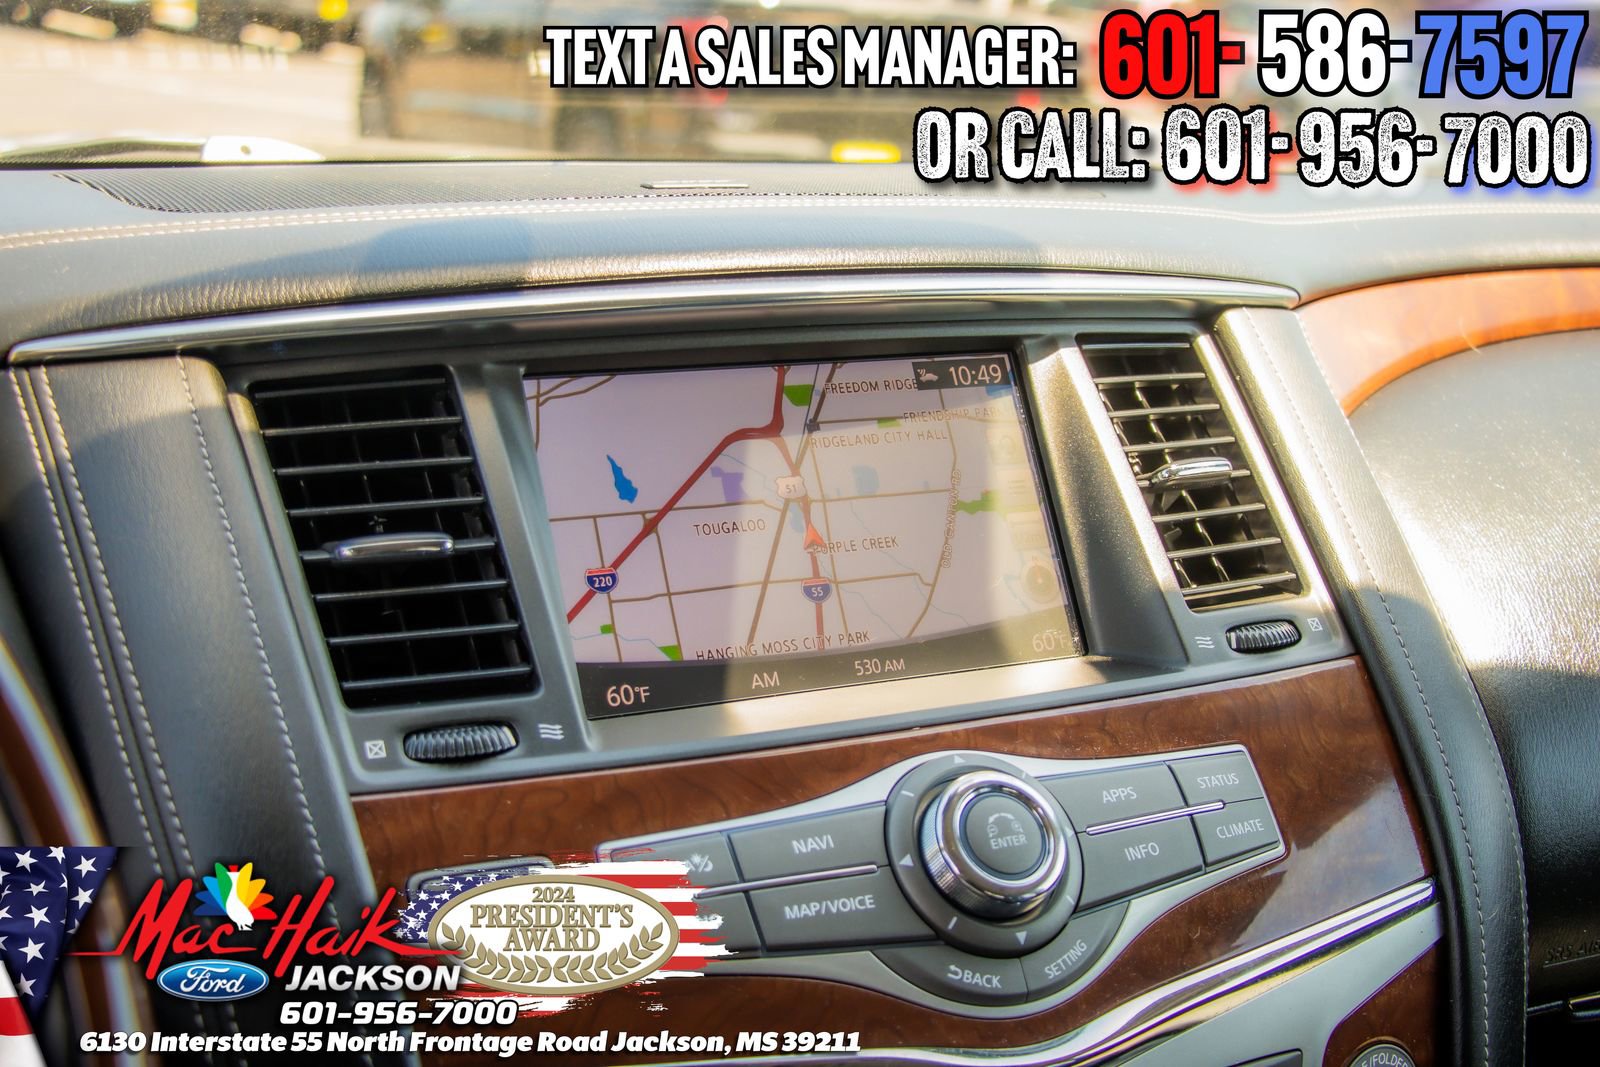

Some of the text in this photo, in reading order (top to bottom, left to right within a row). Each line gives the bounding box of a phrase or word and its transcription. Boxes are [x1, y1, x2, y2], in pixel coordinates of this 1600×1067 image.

[949, 363, 1003, 386] 10:49
[824, 378, 918, 395] FREEDOM RIDGE
[903, 407, 969, 423] FRIENDSHIP
[810, 428, 948, 449] RIDGELAND CITY HALL
[785, 484, 798, 493] 51
[693, 518, 766, 537] TOUGALOO
[813, 536, 898, 555] PURPLE CREEK
[941, 542, 954, 569] OLD
[593, 575, 613, 588] 220
[811, 586, 824, 597] 55
[696, 630, 870, 661] HANGING MOSS CITY PARK
[854, 657, 906, 676] 530 AM
[751, 671, 780, 690] AM
[606, 683, 650, 708] 60°F
[1196, 773, 1240, 789] STATUS
[1102, 786, 1137, 804] APPS
[1216, 818, 1265, 839] CLIMATE
[792, 834, 835, 854] NAVI
[990, 834, 1028, 850] ENTER
[1124, 842, 1160, 862] INFO
[783, 894, 876, 920] MAP/VOICE
[1044, 939, 1088, 980] SETTING
[963, 969, 1002, 989] BACK
